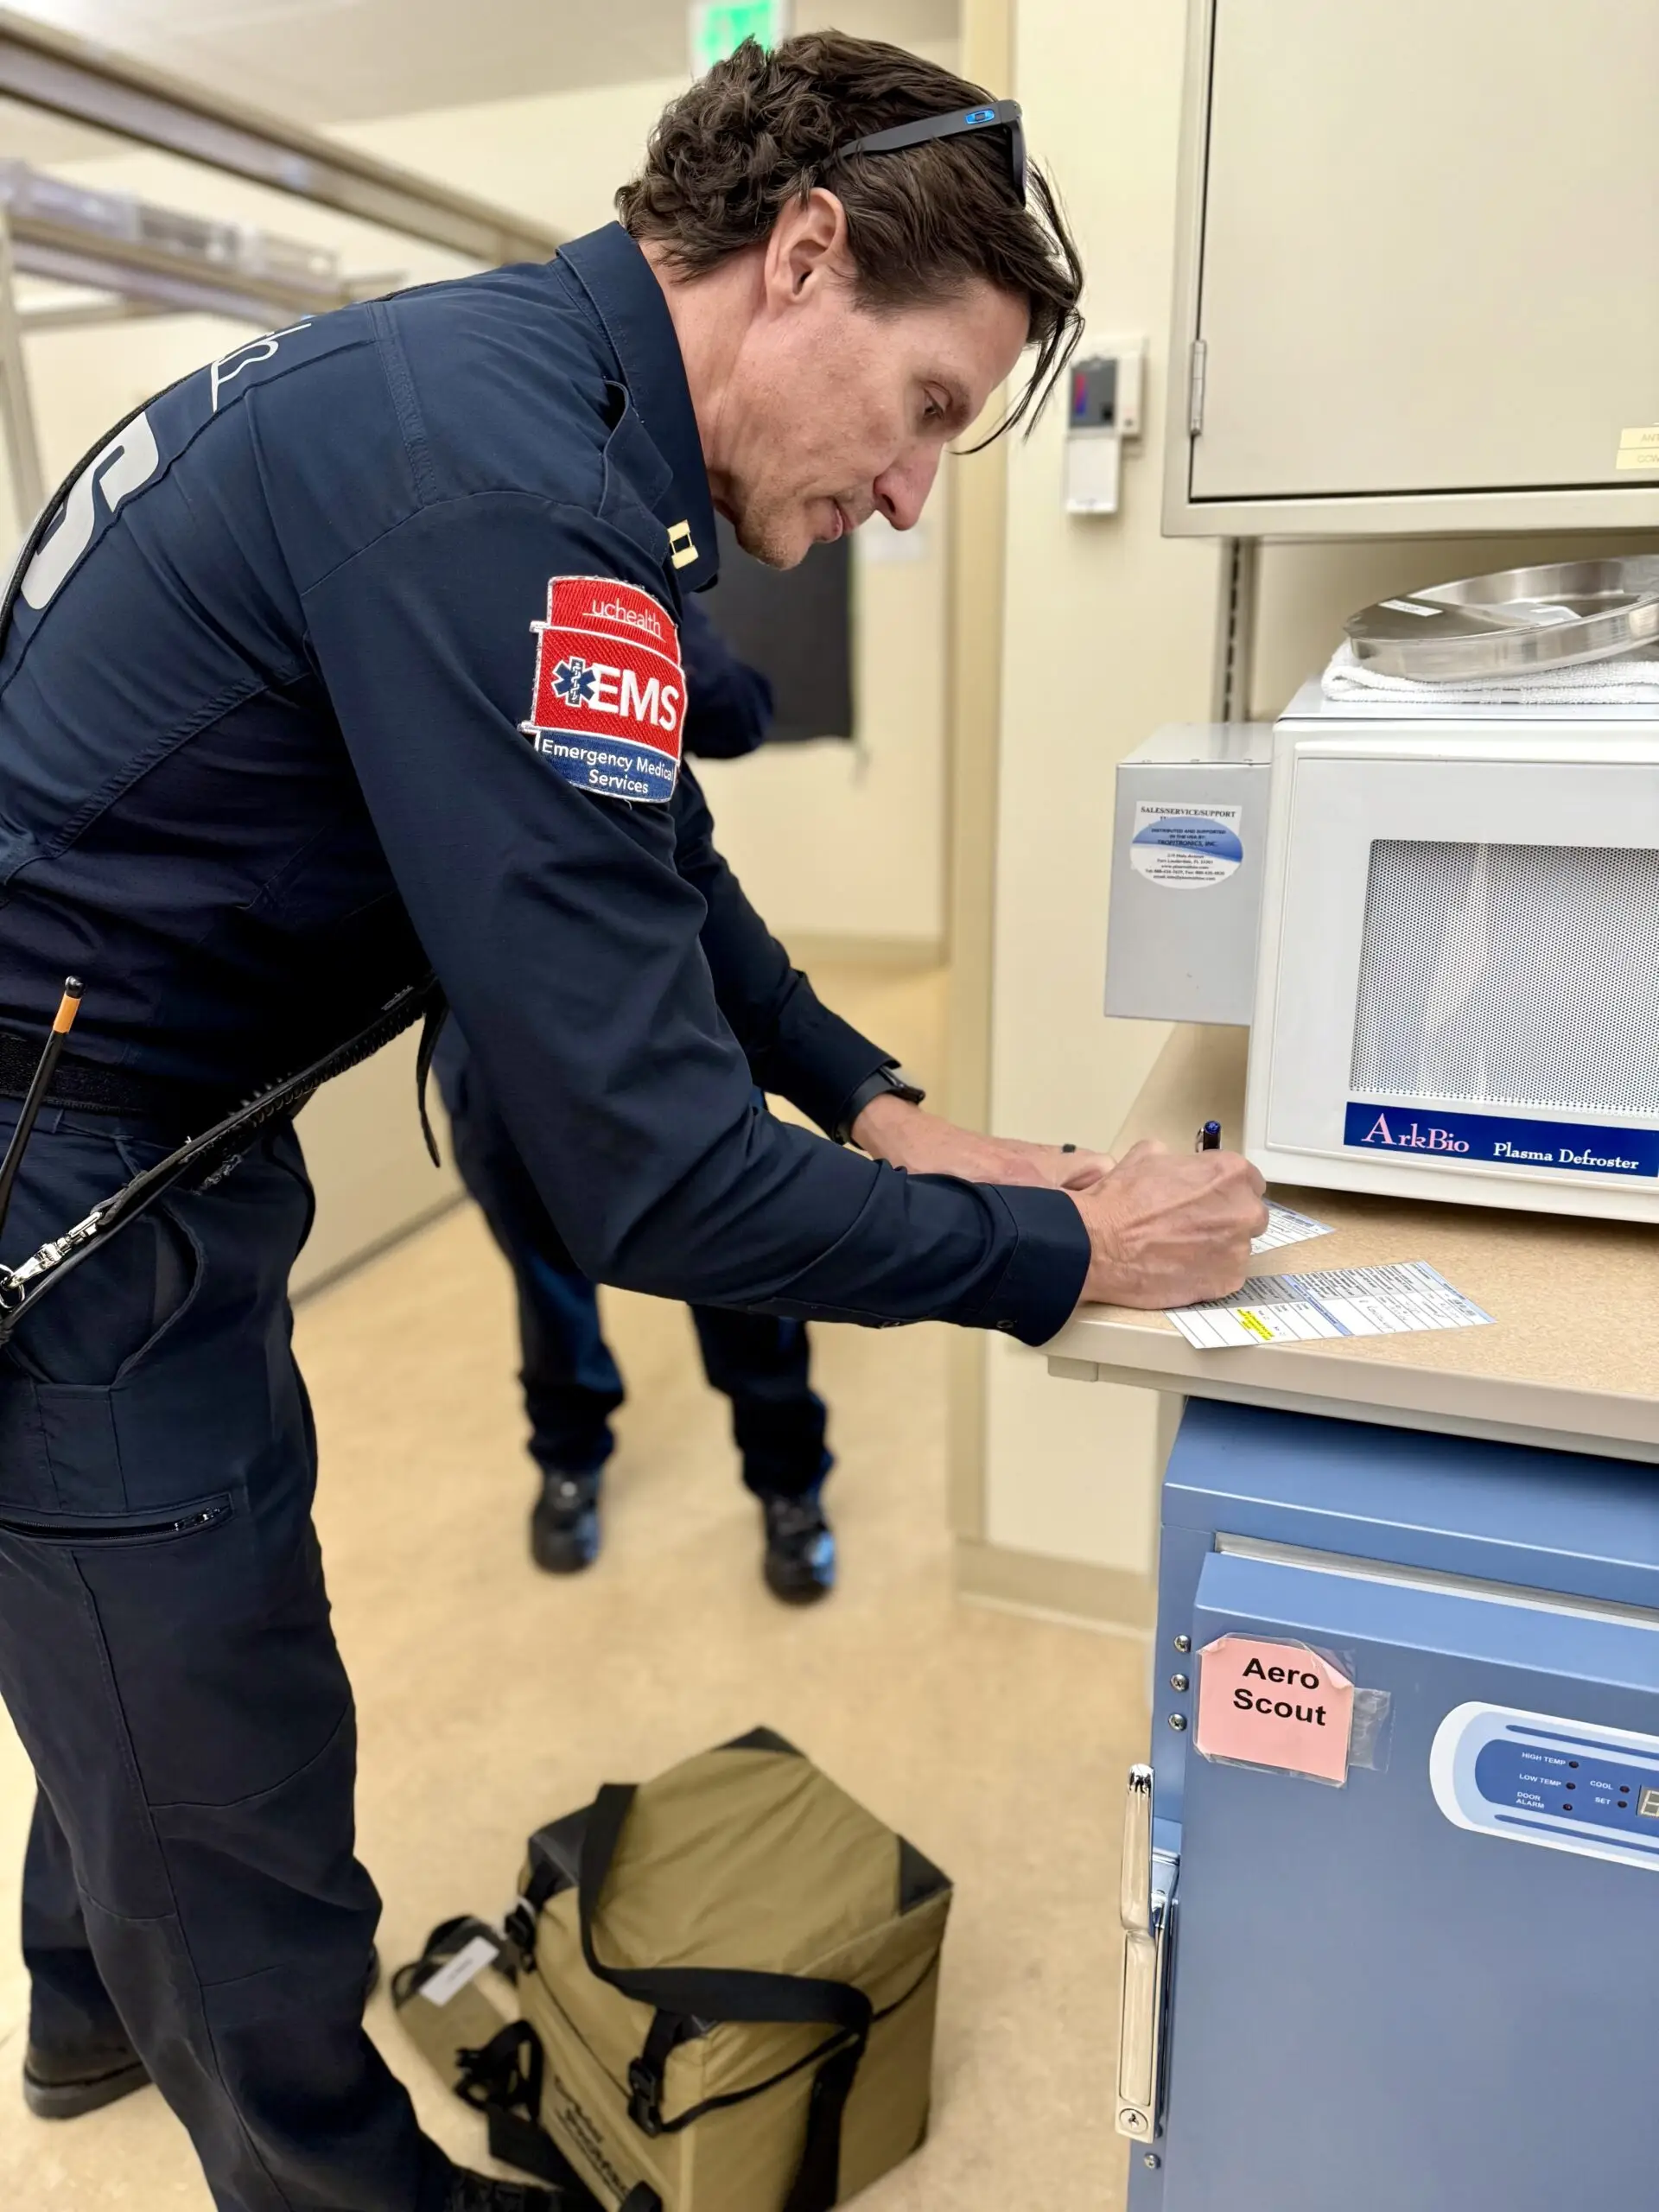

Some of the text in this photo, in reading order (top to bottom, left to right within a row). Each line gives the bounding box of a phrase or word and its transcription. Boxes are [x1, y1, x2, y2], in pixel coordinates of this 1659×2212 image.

[591, 597, 661, 637] uchealth
[589, 662, 680, 732] EMS
[542, 738, 674, 781] Emergency Medical
[588, 768, 649, 794] Services
[1141, 806, 1236, 817] SALES/SERVICE/SUPPORT
[1360, 1112, 1470, 1153] ArkBio
[1493, 1142, 1639, 1170] Plasma Defroster
[1242, 1657, 1320, 1690] Aero
[1232, 1688, 1327, 1726] Scout
[1522, 1751, 1566, 1765] HIGH TEMP
[1519, 1773, 1561, 1786] LOW TEMP
[1589, 1780, 1614, 1790] COOL
[1516, 1791, 1541, 1802] DOOR
[1516, 1798, 1545, 1809] ALARM
[1594, 1796, 1611, 1805] SET
